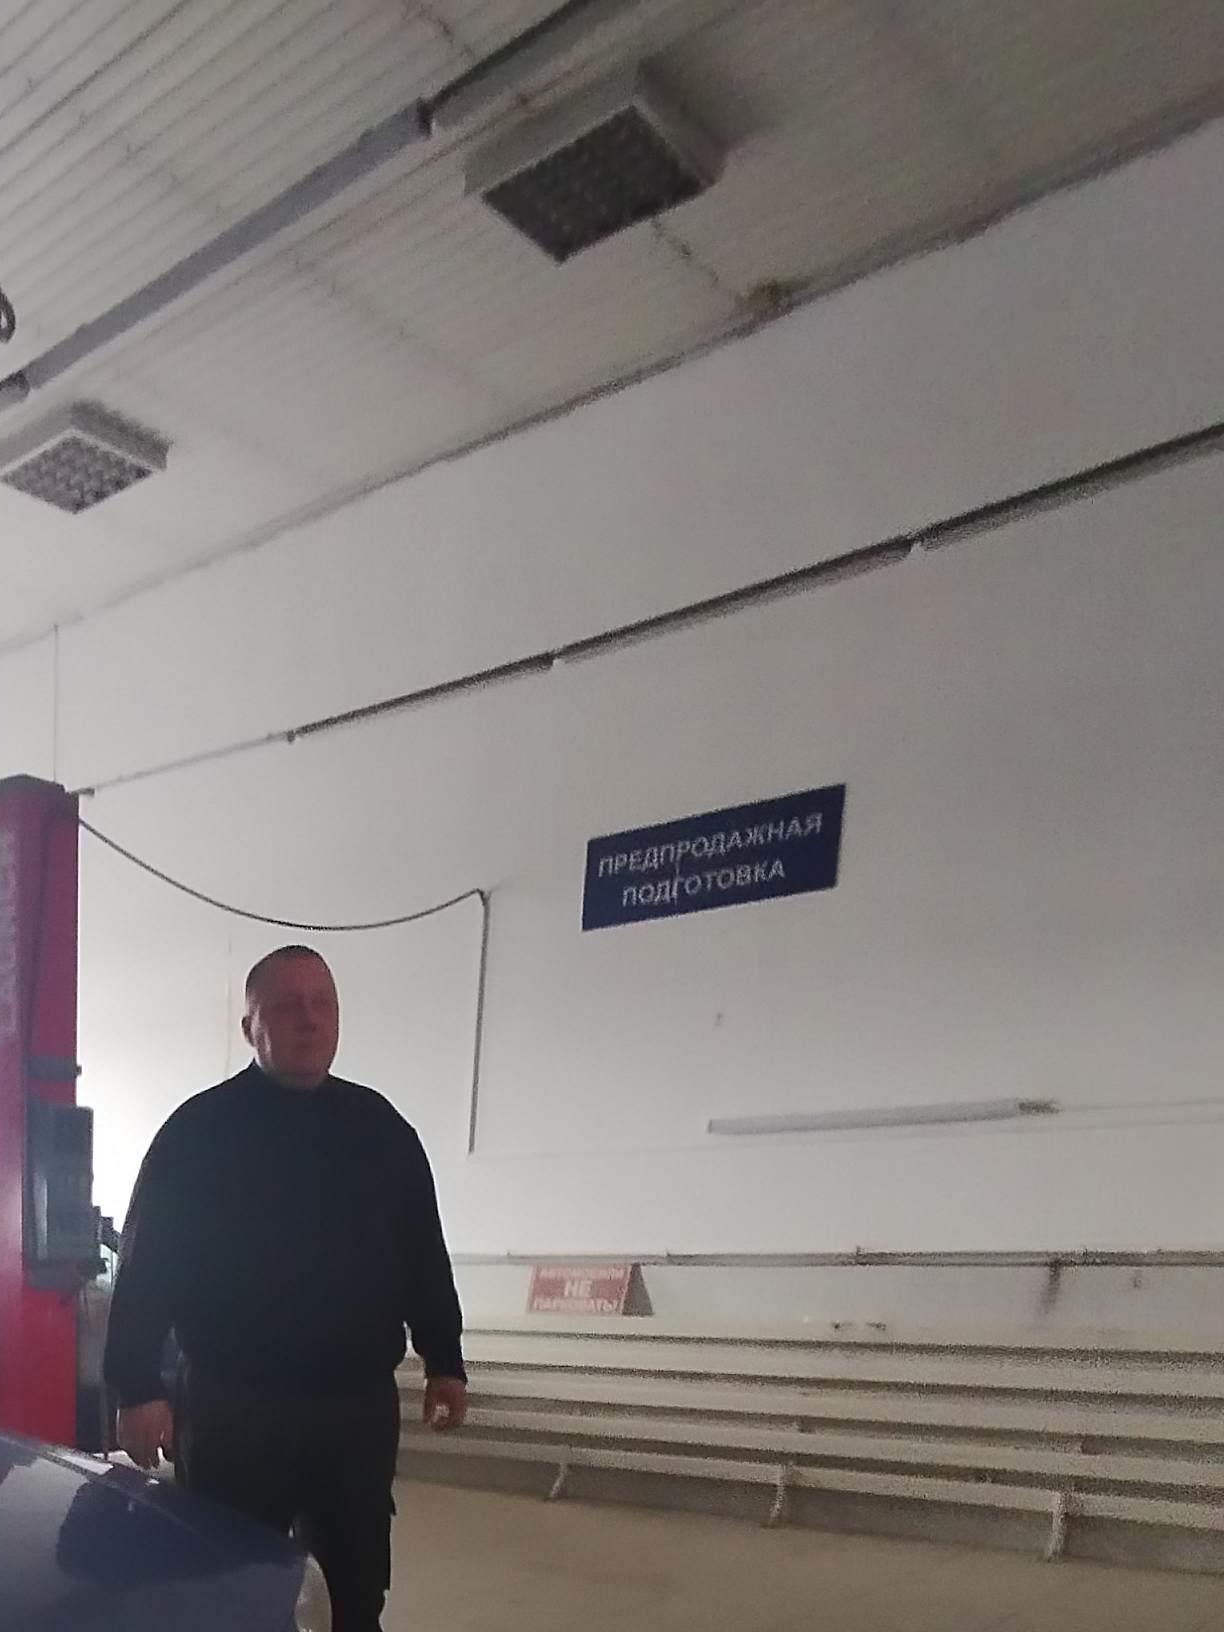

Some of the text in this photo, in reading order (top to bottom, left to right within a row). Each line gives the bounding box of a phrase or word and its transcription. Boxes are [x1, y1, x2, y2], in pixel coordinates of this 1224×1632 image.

[598, 812, 823, 878] ПРЕДПРОДАЖНАЯ
[622, 859, 786, 907] ПОДГОТОВКА
[564, 1278, 593, 1298] НЕ
